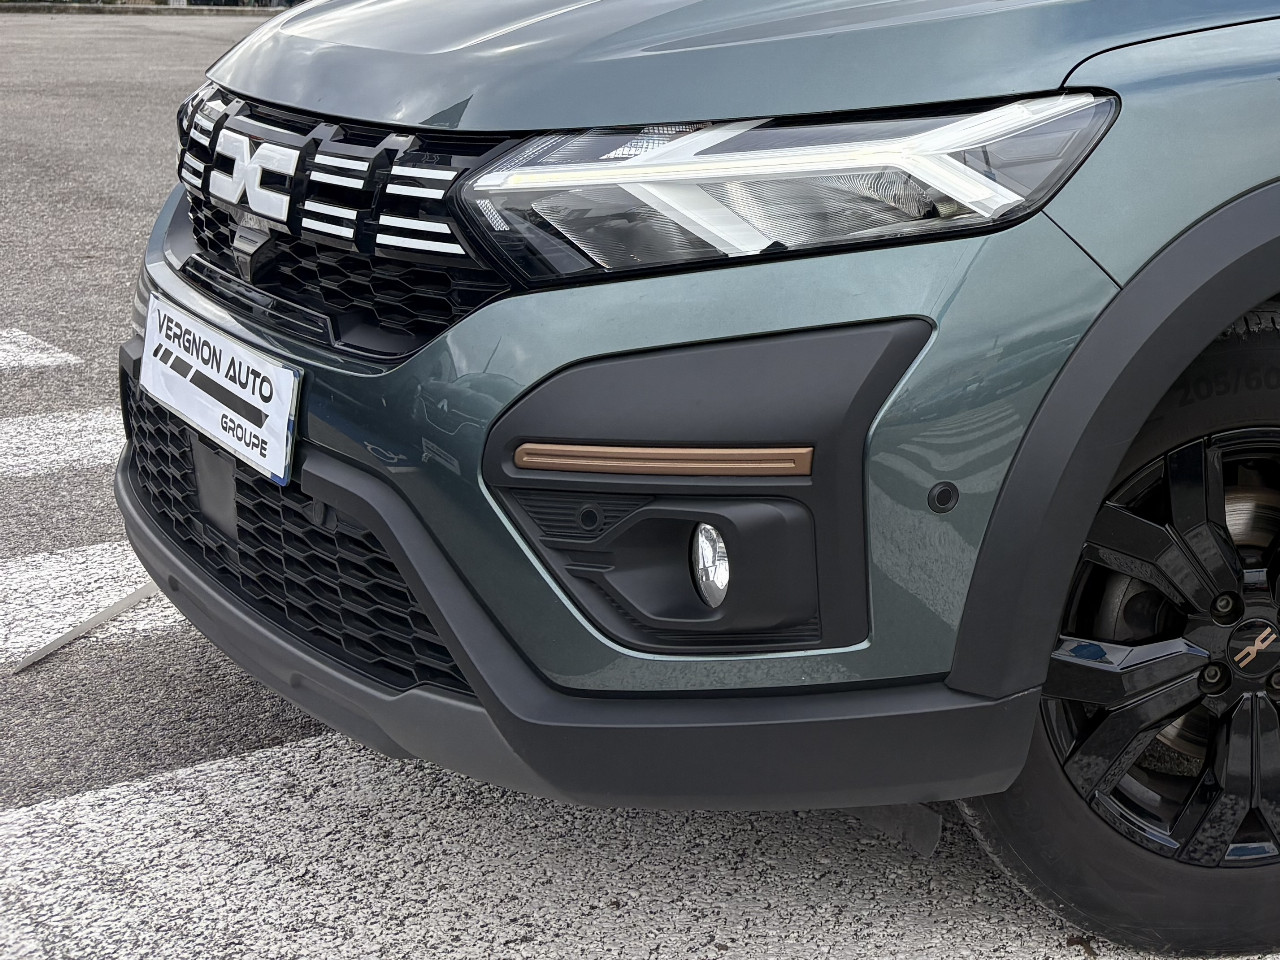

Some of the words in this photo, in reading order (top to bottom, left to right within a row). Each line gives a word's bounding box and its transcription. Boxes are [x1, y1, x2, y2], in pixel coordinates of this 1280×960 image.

[157, 308, 223, 375] VERGNON
[224, 356, 275, 404] AUTO
[221, 413, 269, 459] GROUPE
